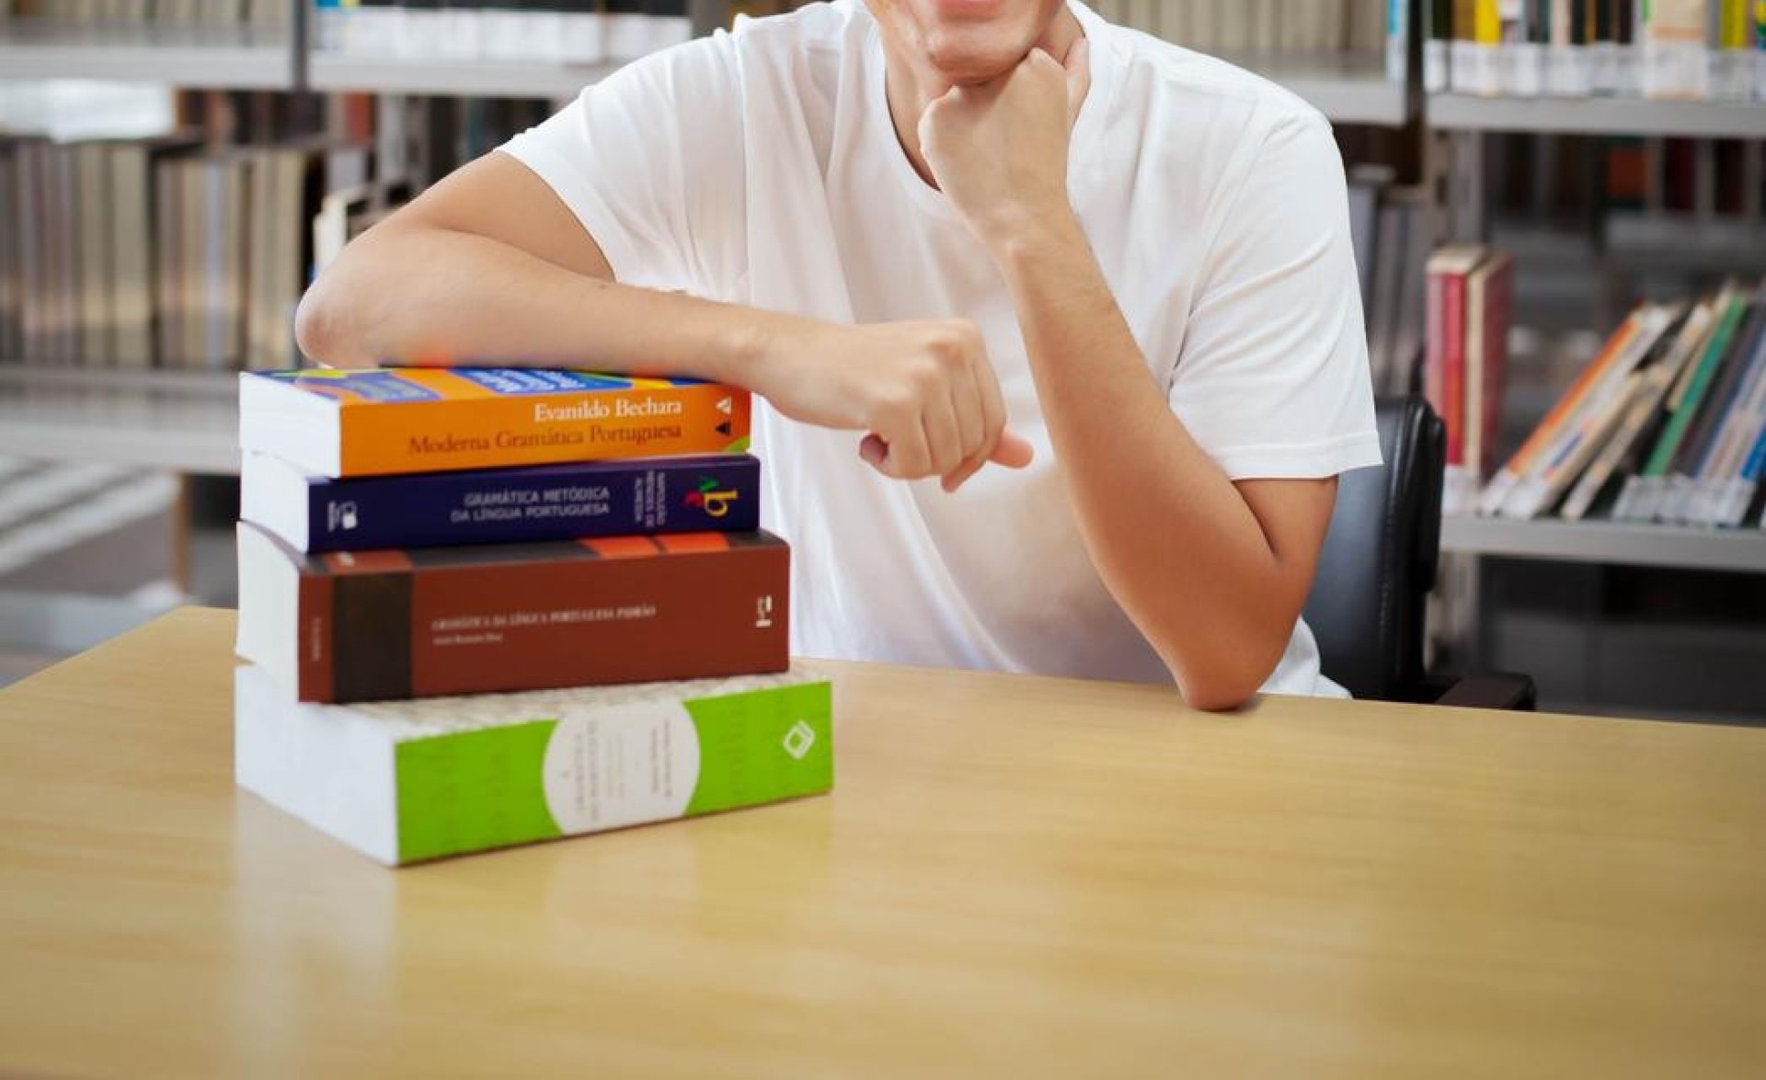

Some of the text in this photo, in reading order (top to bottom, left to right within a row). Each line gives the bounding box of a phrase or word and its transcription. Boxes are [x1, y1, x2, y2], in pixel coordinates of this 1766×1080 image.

[534, 398, 682, 423] Evanildo Bechara
[408, 422, 682, 455] Moderna Gramática Portuguesa
[464, 485, 610, 507] GRAMÁTICA METÓDICA
[450, 503, 609, 523] DA LÍNGUA PORTUGUESA
